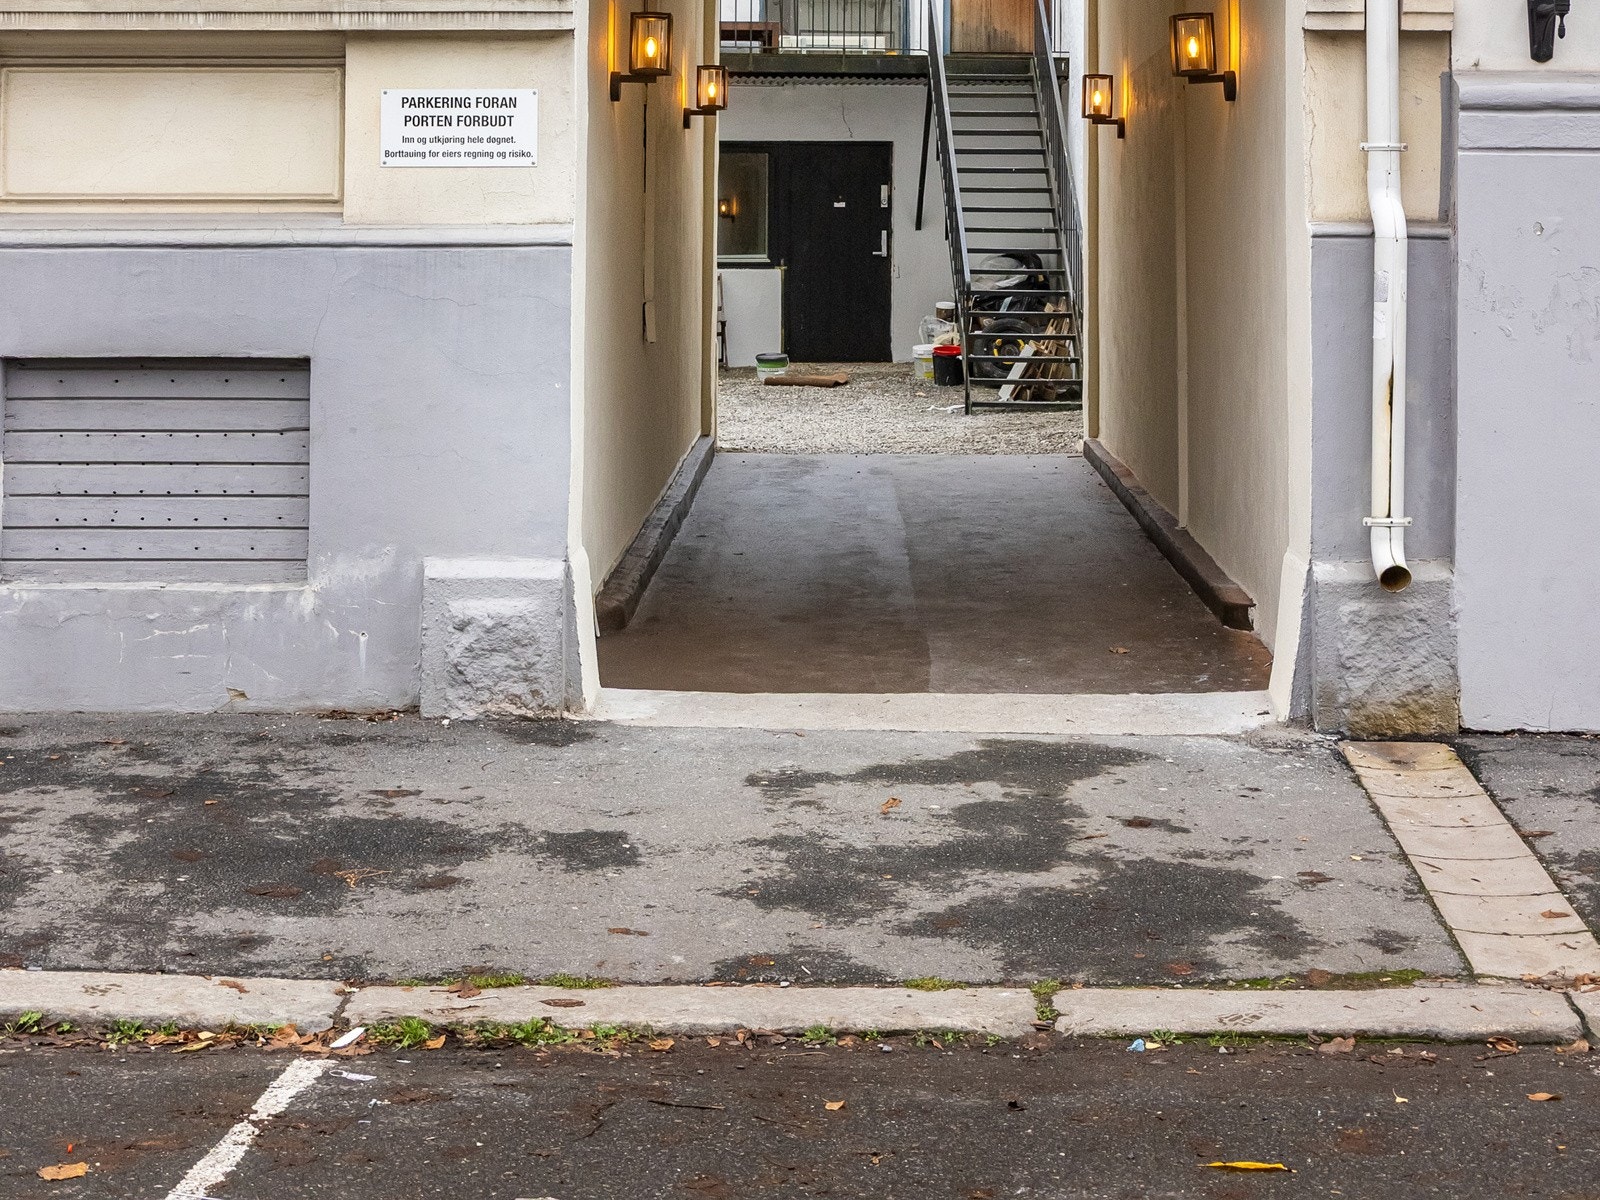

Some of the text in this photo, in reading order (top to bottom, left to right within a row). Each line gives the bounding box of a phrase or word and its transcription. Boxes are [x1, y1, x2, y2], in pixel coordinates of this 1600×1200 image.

[401, 96, 517, 109] PARKERING FORAN
[404, 115, 515, 127] PORTEN FORBUDT
[402, 135, 516, 146] Inn og utkjøring hele døgnet.
[384, 149, 534, 160] Borttauing for eiers regning og risiko.
